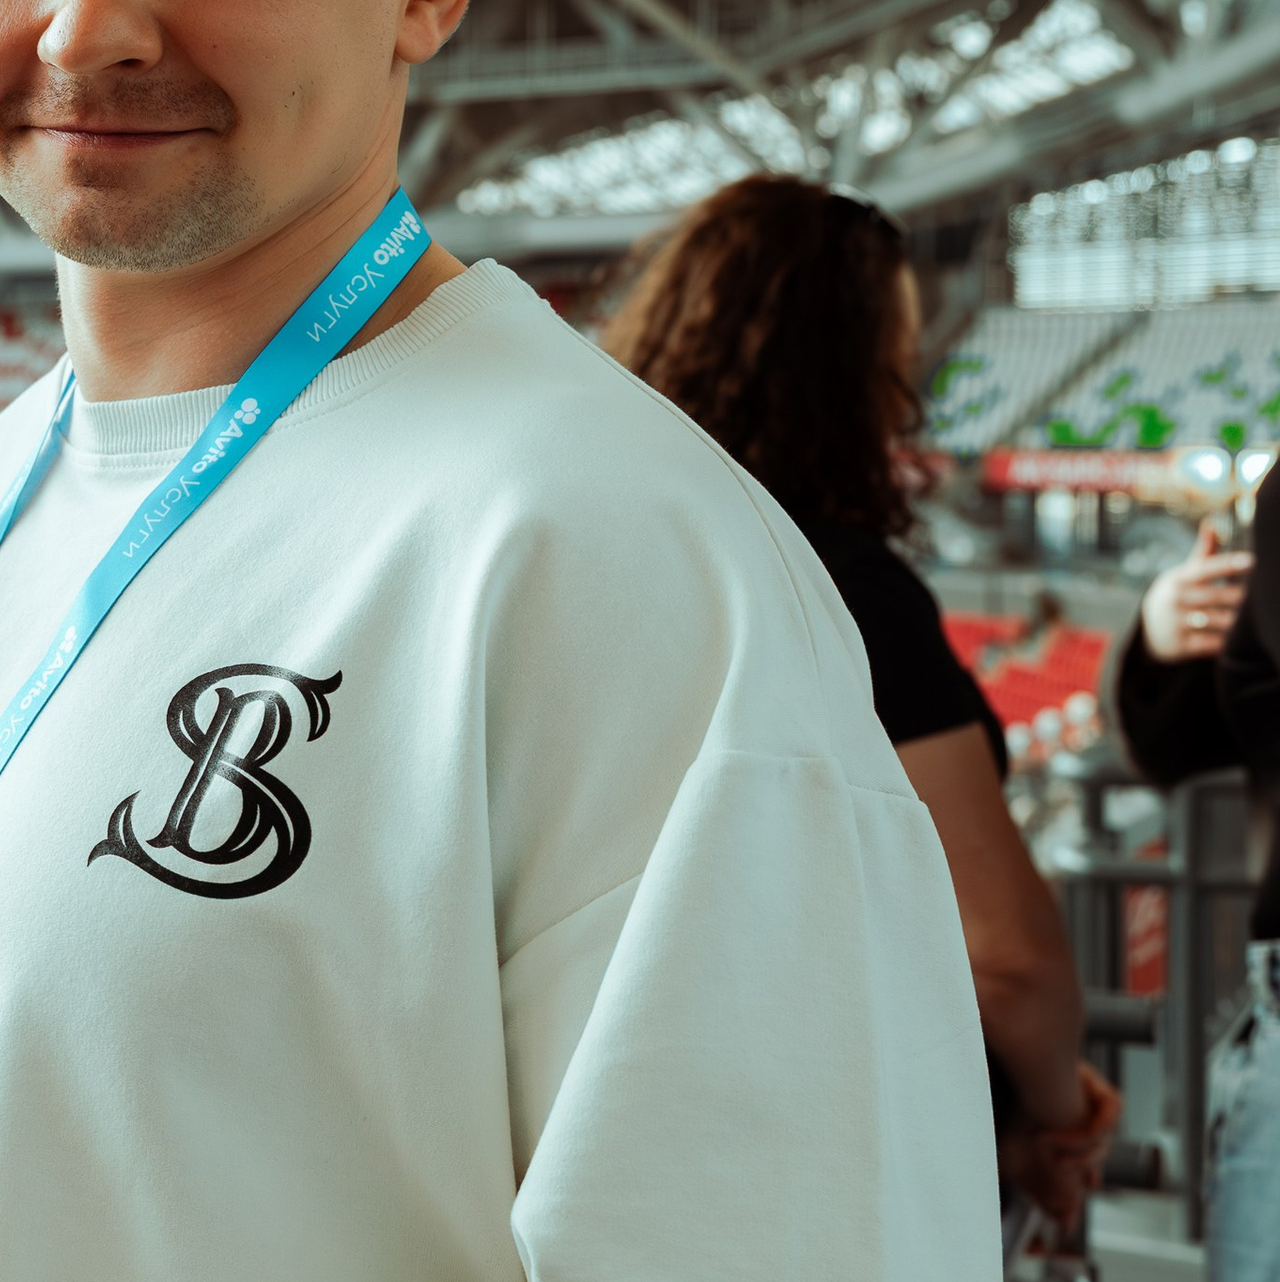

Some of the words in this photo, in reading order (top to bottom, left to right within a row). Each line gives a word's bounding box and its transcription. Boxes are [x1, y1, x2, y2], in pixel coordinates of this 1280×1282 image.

[373, 220, 415, 265] Avito
[306, 263, 385, 342] Услуги
[192, 418, 244, 473] Avito
[122, 475, 200, 558] Услуги
[20, 653, 63, 710] Avito
